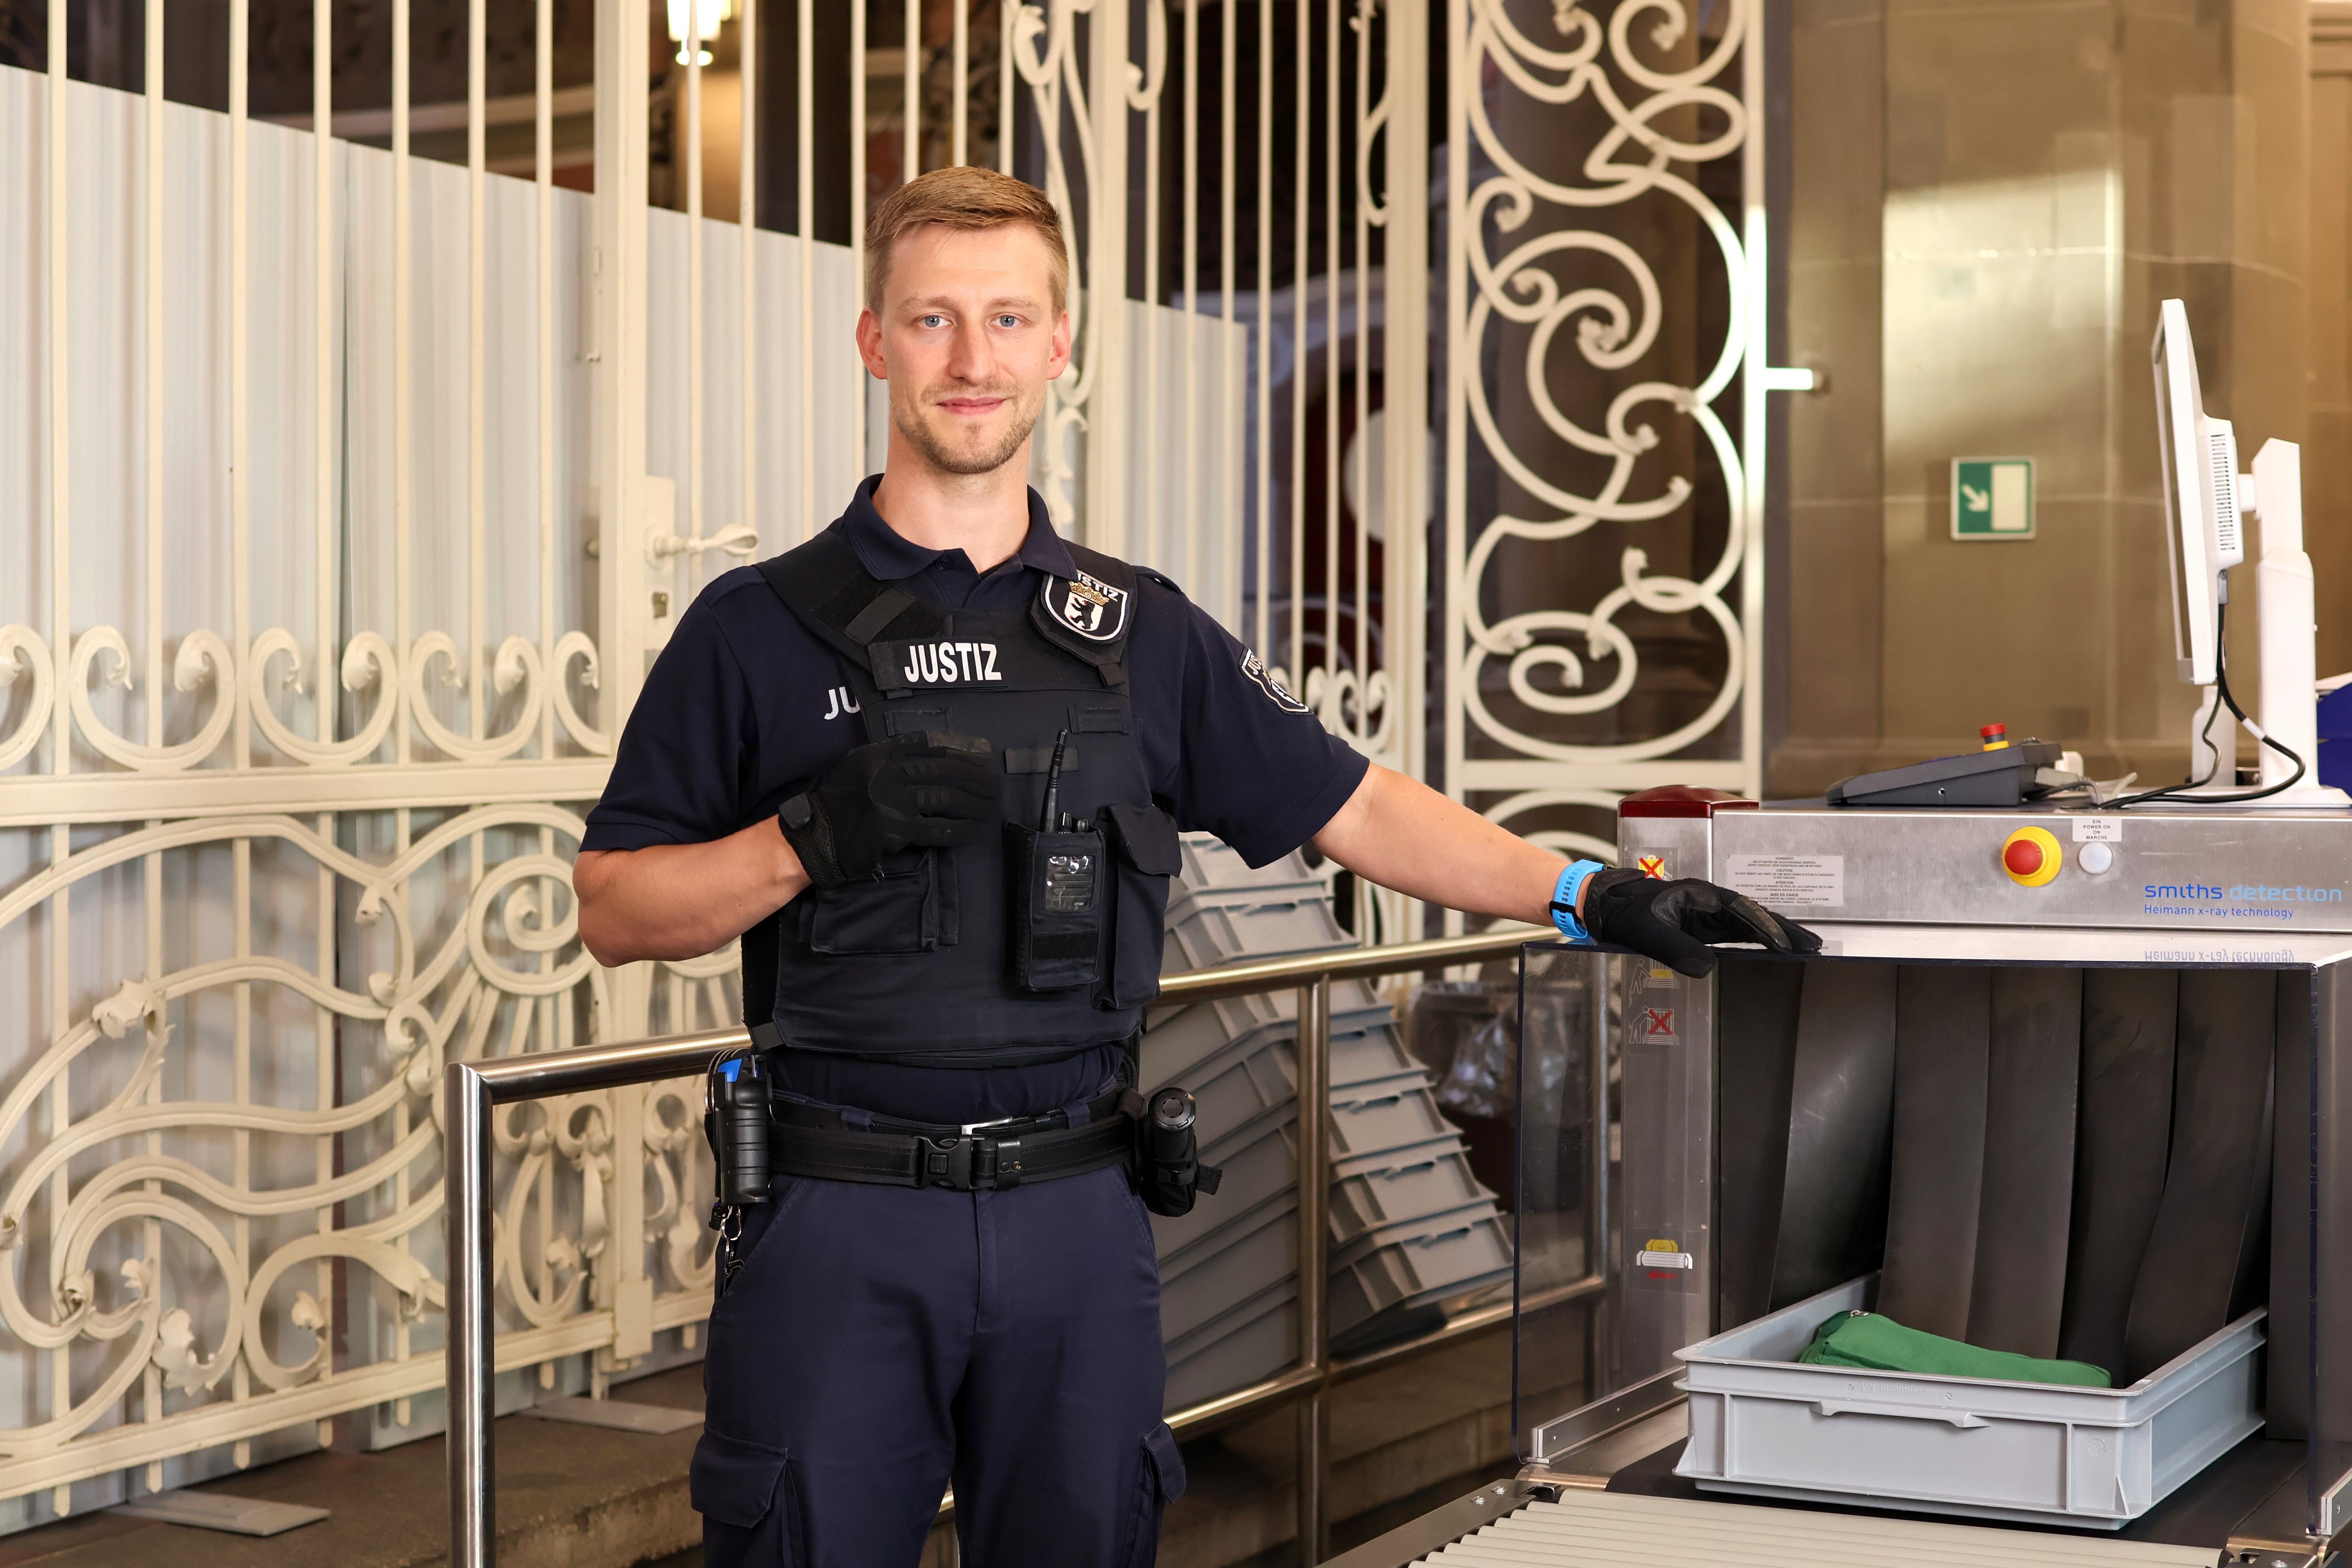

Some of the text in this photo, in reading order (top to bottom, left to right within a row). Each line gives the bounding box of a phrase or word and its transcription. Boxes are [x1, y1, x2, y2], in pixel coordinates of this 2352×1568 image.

[1078, 573, 1118, 602] STIZ
[904, 642, 1002, 682] JUSTIZ
[1247, 652, 1262, 675] JUS
[2145, 884, 2343, 902] smiths detection
[2144, 904, 2294, 920] Heimann x-ray technology
